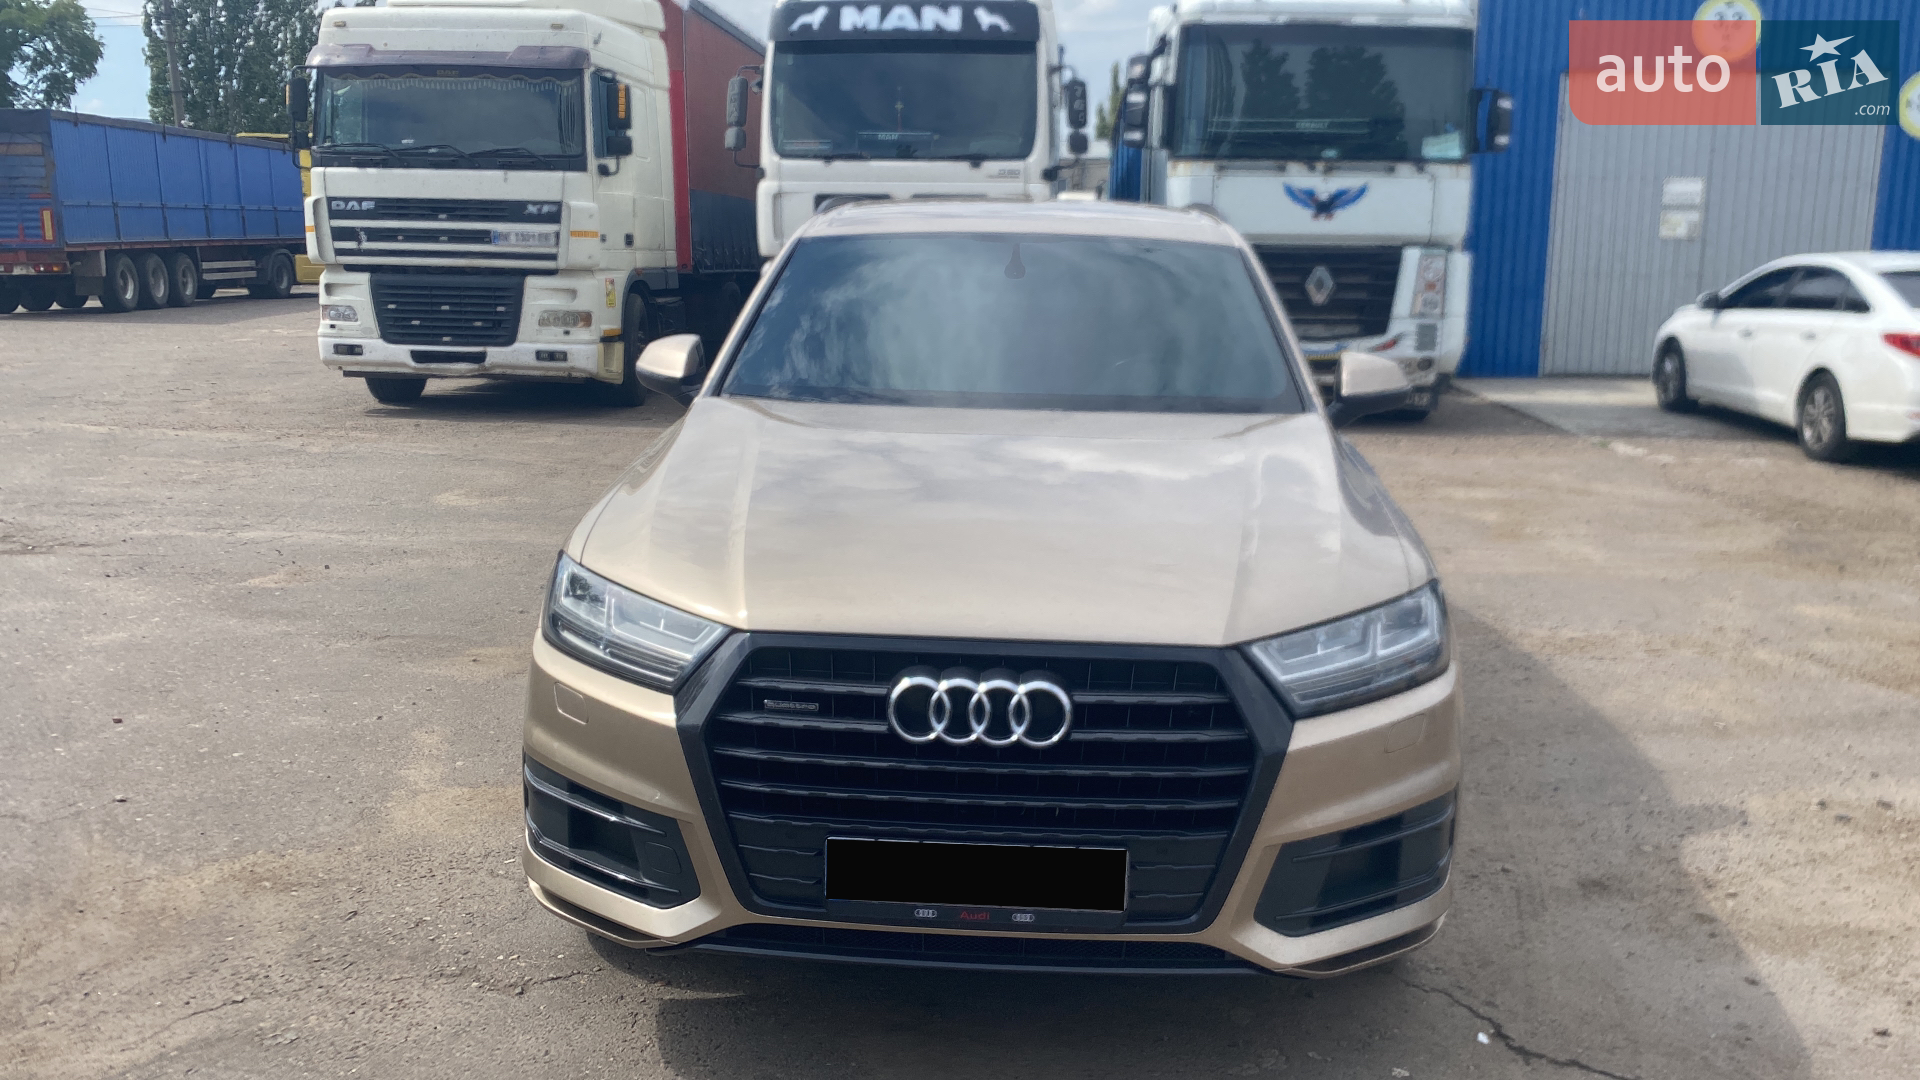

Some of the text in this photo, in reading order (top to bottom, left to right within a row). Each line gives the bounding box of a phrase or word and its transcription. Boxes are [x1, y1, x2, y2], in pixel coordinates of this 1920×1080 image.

[838, 5, 963, 32] MAN
[877, 133, 899, 141] MAN
[331, 200, 376, 211] DAF
[960, 911, 990, 920] Audi
